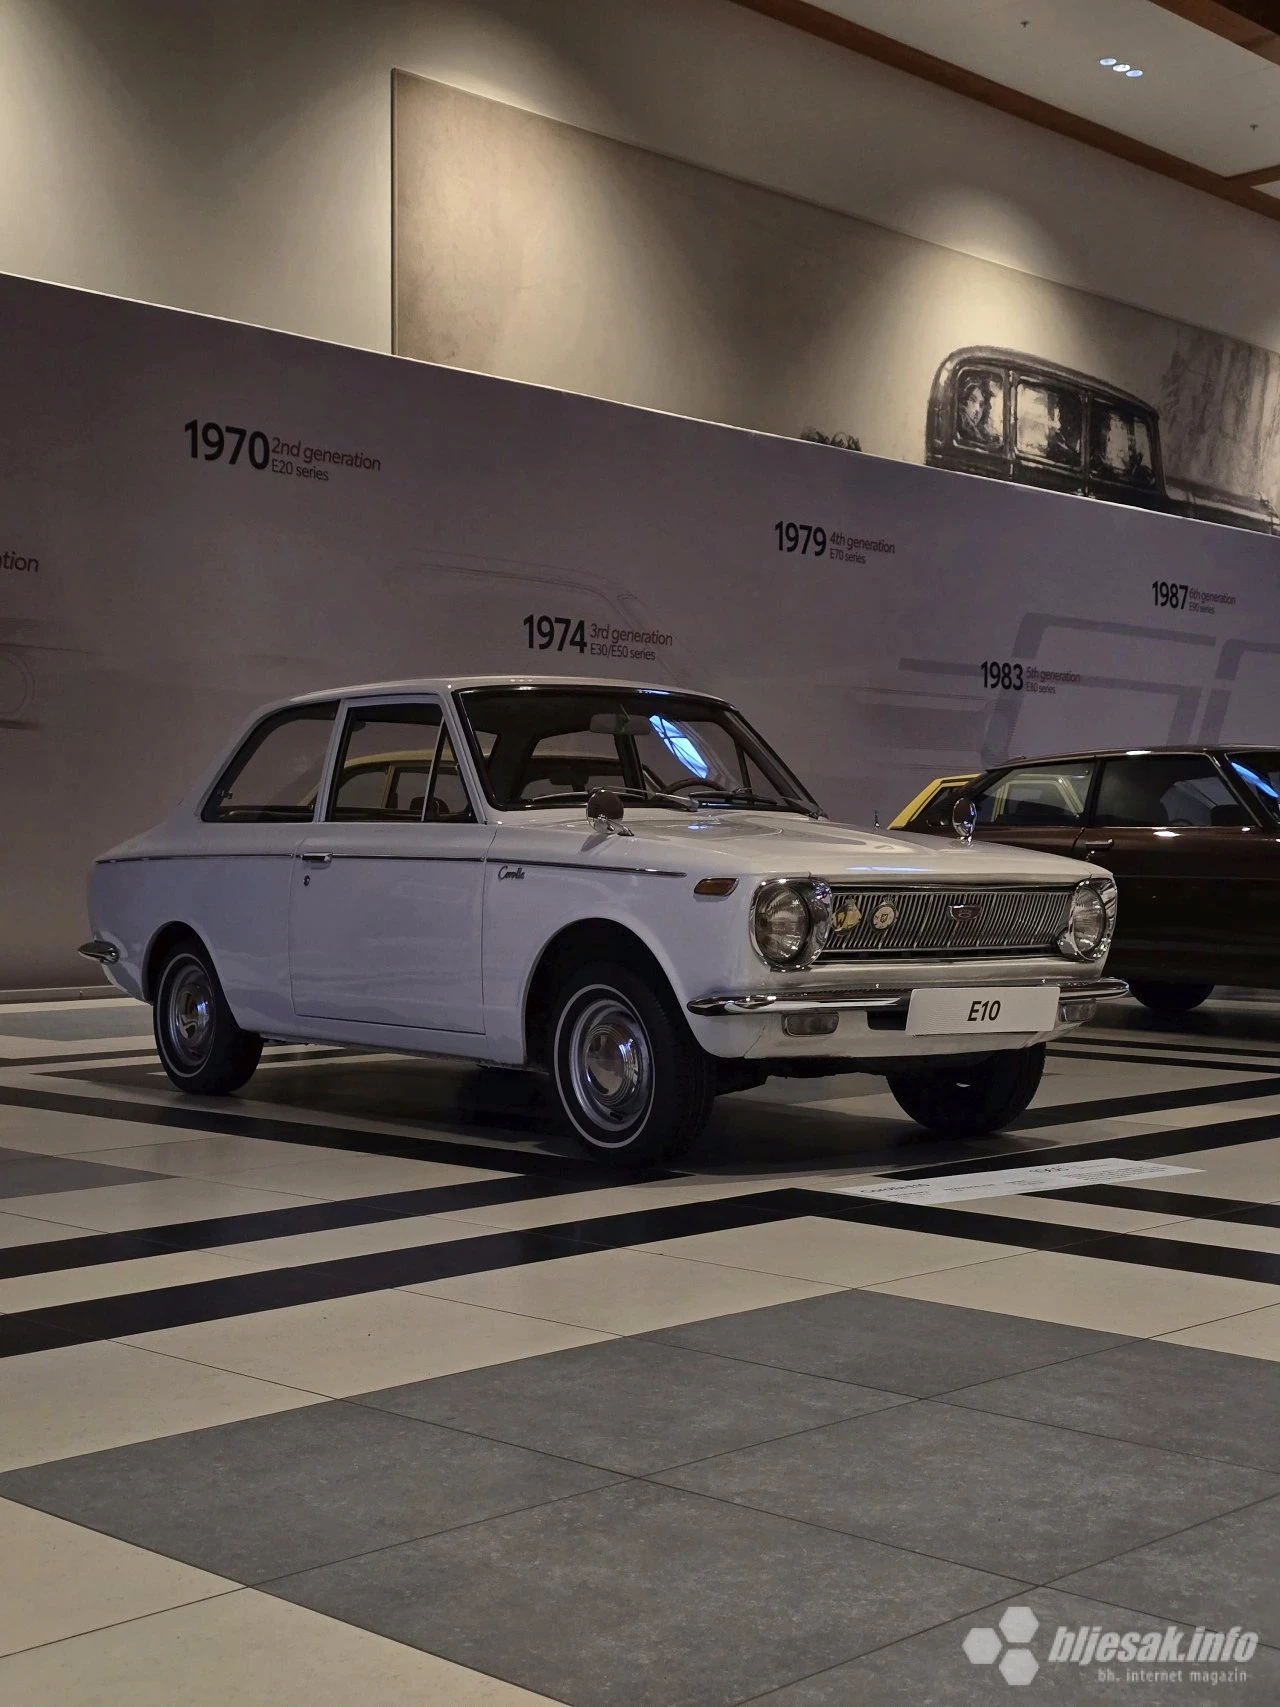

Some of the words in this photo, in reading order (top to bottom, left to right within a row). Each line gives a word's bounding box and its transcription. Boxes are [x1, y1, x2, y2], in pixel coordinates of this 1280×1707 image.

[184, 419, 270, 470] 1970
[271, 437, 301, 457] 2nd
[303, 444, 381, 472] generation
[271, 459, 294, 476] E20
[296, 464, 329, 481] series
[774, 520, 827, 557] 1979
[829, 531, 846, 546] 4th
[847, 536, 896, 554] generation
[0, 550, 39, 573] tion
[829, 547, 844, 561] E70
[844, 551, 866, 565] series
[1152, 580, 1189, 610] 1987
[523, 613, 588, 654] 1974
[590, 623, 610, 640] 3rd
[611, 627, 673, 647] generation
[590, 642, 629, 660] E30/E50
[629, 647, 656, 661] series
[980, 660, 1024, 691] 1983
[1026, 666, 1040, 679] 5th
[1040, 669, 1081, 683] generation
[967, 1000, 1001, 1022] E10
